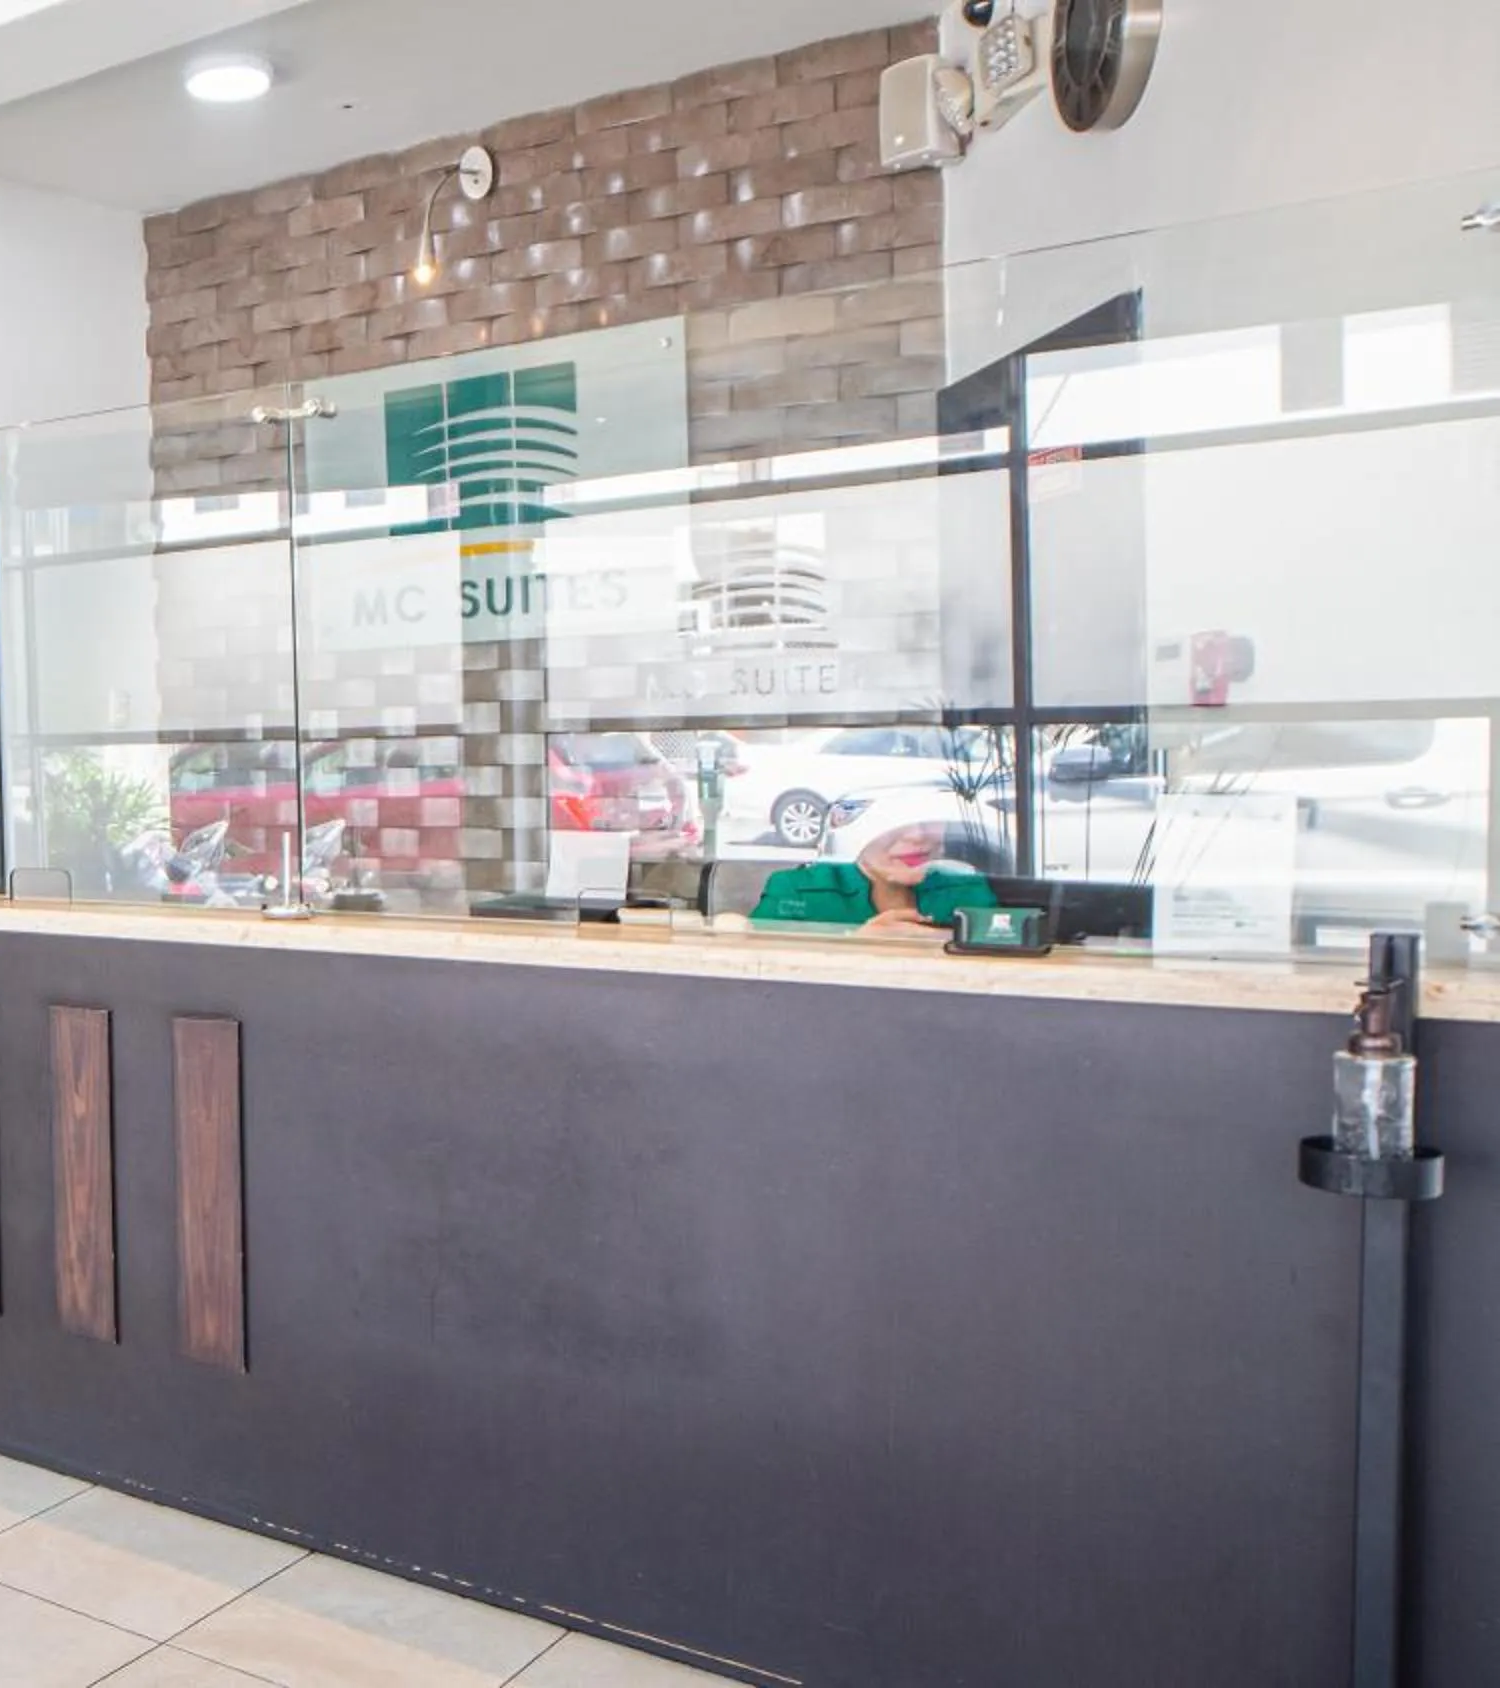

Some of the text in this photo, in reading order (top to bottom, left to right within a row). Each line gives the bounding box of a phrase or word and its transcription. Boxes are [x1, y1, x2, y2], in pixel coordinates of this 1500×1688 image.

[353, 569, 629, 627] MC SUITES
[729, 663, 866, 697] SUITE
